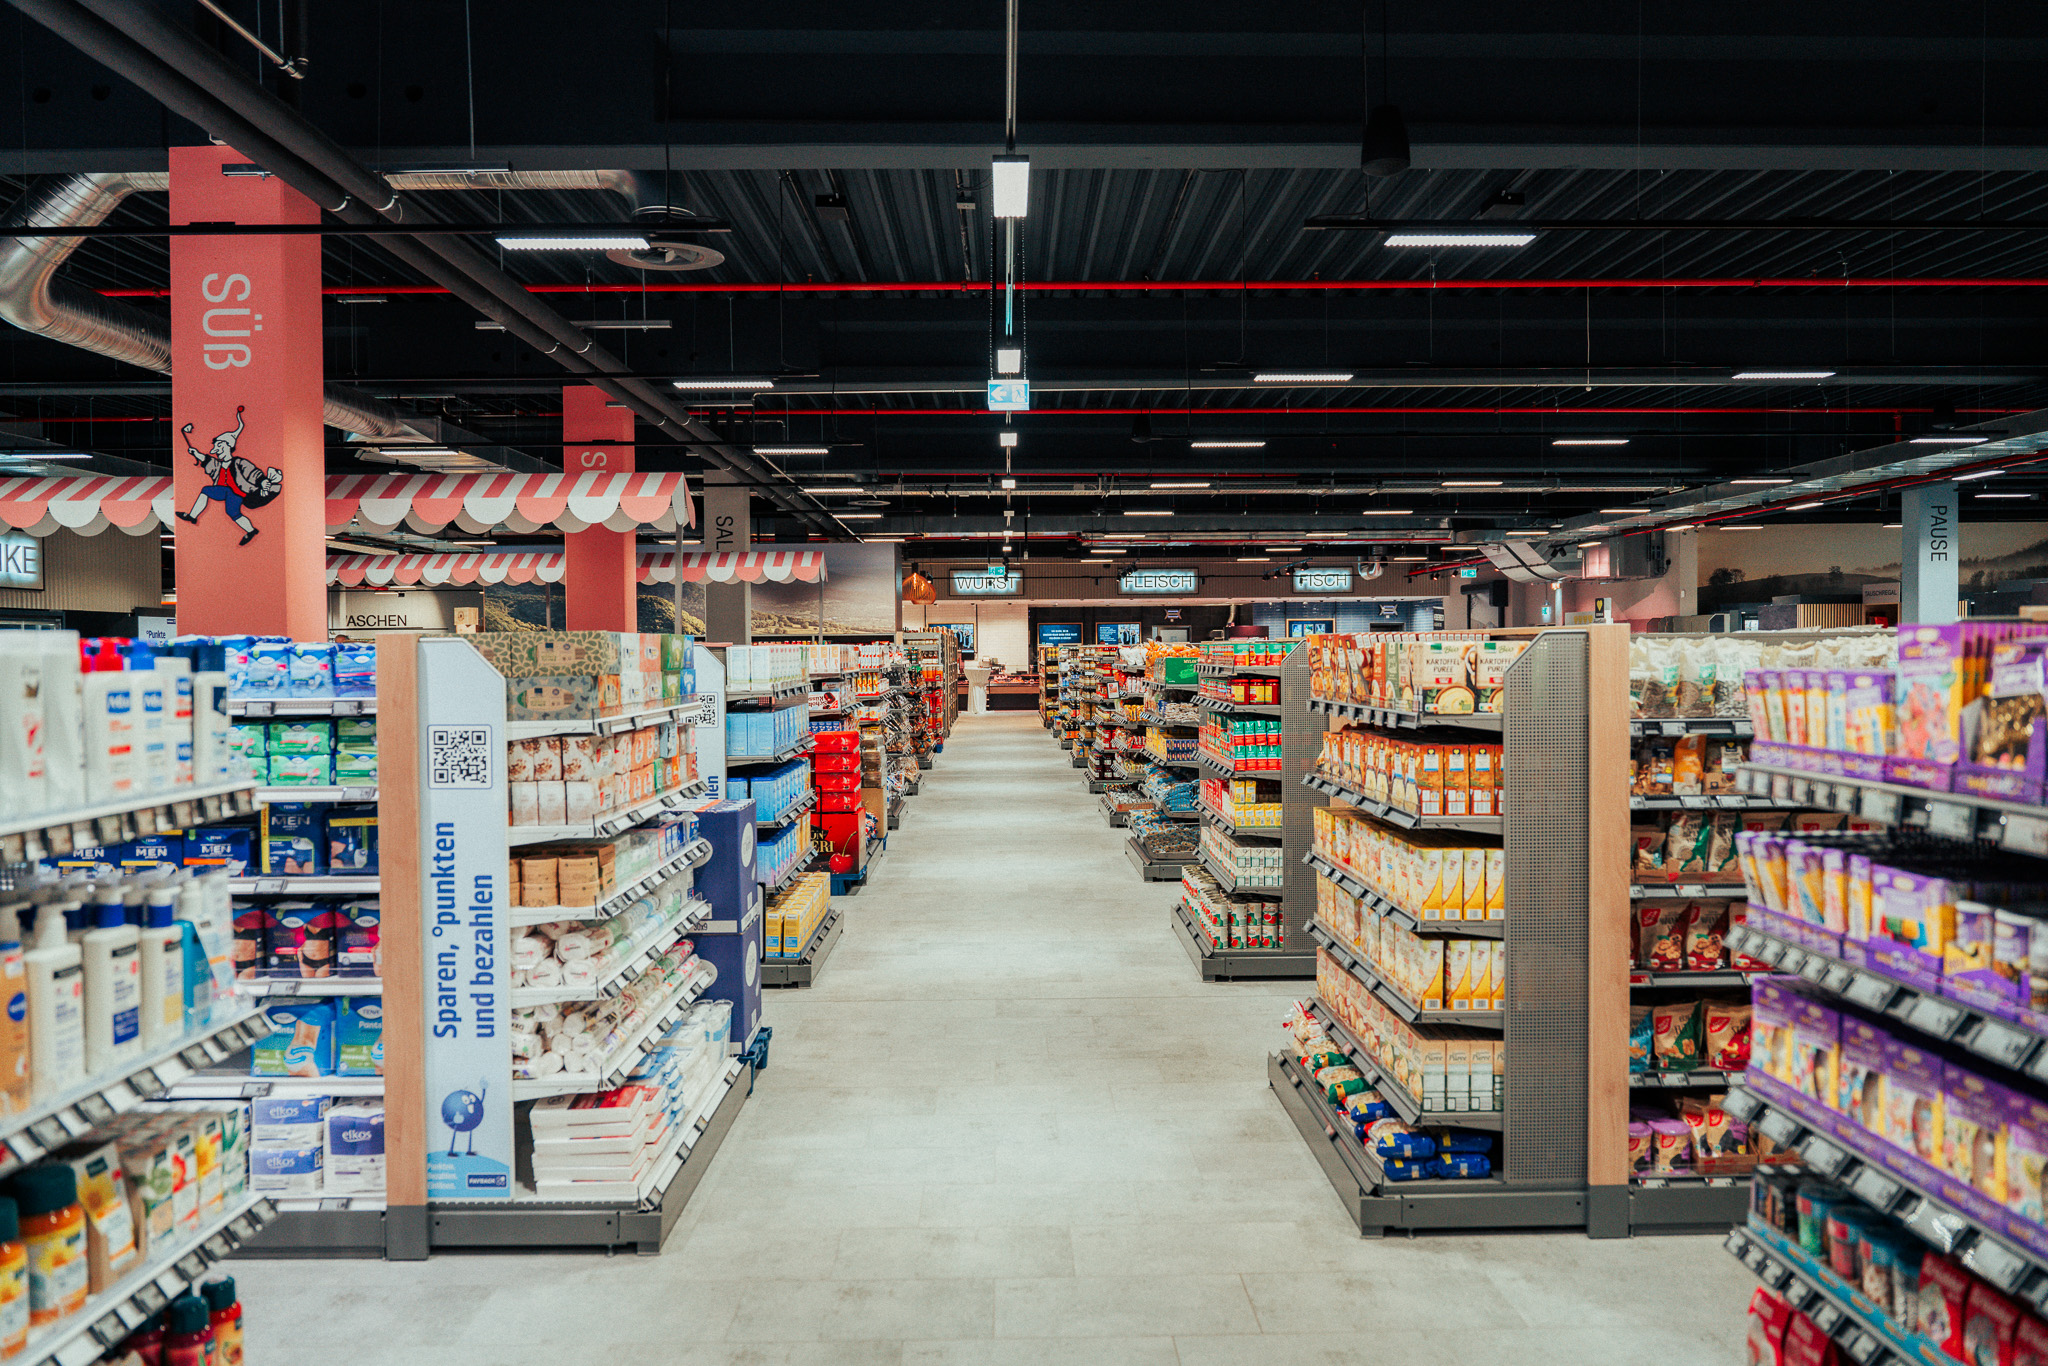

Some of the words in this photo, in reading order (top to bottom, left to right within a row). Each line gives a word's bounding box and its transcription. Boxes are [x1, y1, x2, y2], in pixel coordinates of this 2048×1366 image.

[581, 451, 607, 473] S
[716, 515, 733, 552] SAL
[1930, 505, 1947, 561] PAUSE
[956, 576, 1016, 590] WURST
[1125, 576, 1193, 588] FLEISCH
[1300, 574, 1348, 587] FISCH
[346, 614, 407, 627] ASCHEN
[271, 816, 311, 826] MEN
[810, 831, 824, 840] ON
[201, 844, 232, 854] MEN
[812, 840, 834, 853] ERI
[73, 848, 105, 858] MEN
[136, 848, 168, 858] MEN
[468, 874, 494, 986] bezahlen
[433, 944, 462, 1038] Sparen,
[469, 993, 495, 1038] und
[276, 1026, 295, 1034] ants
[269, 1107, 299, 1118] elkos
[342, 1130, 373, 1142] elkos
[266, 1158, 296, 1169] elkos
